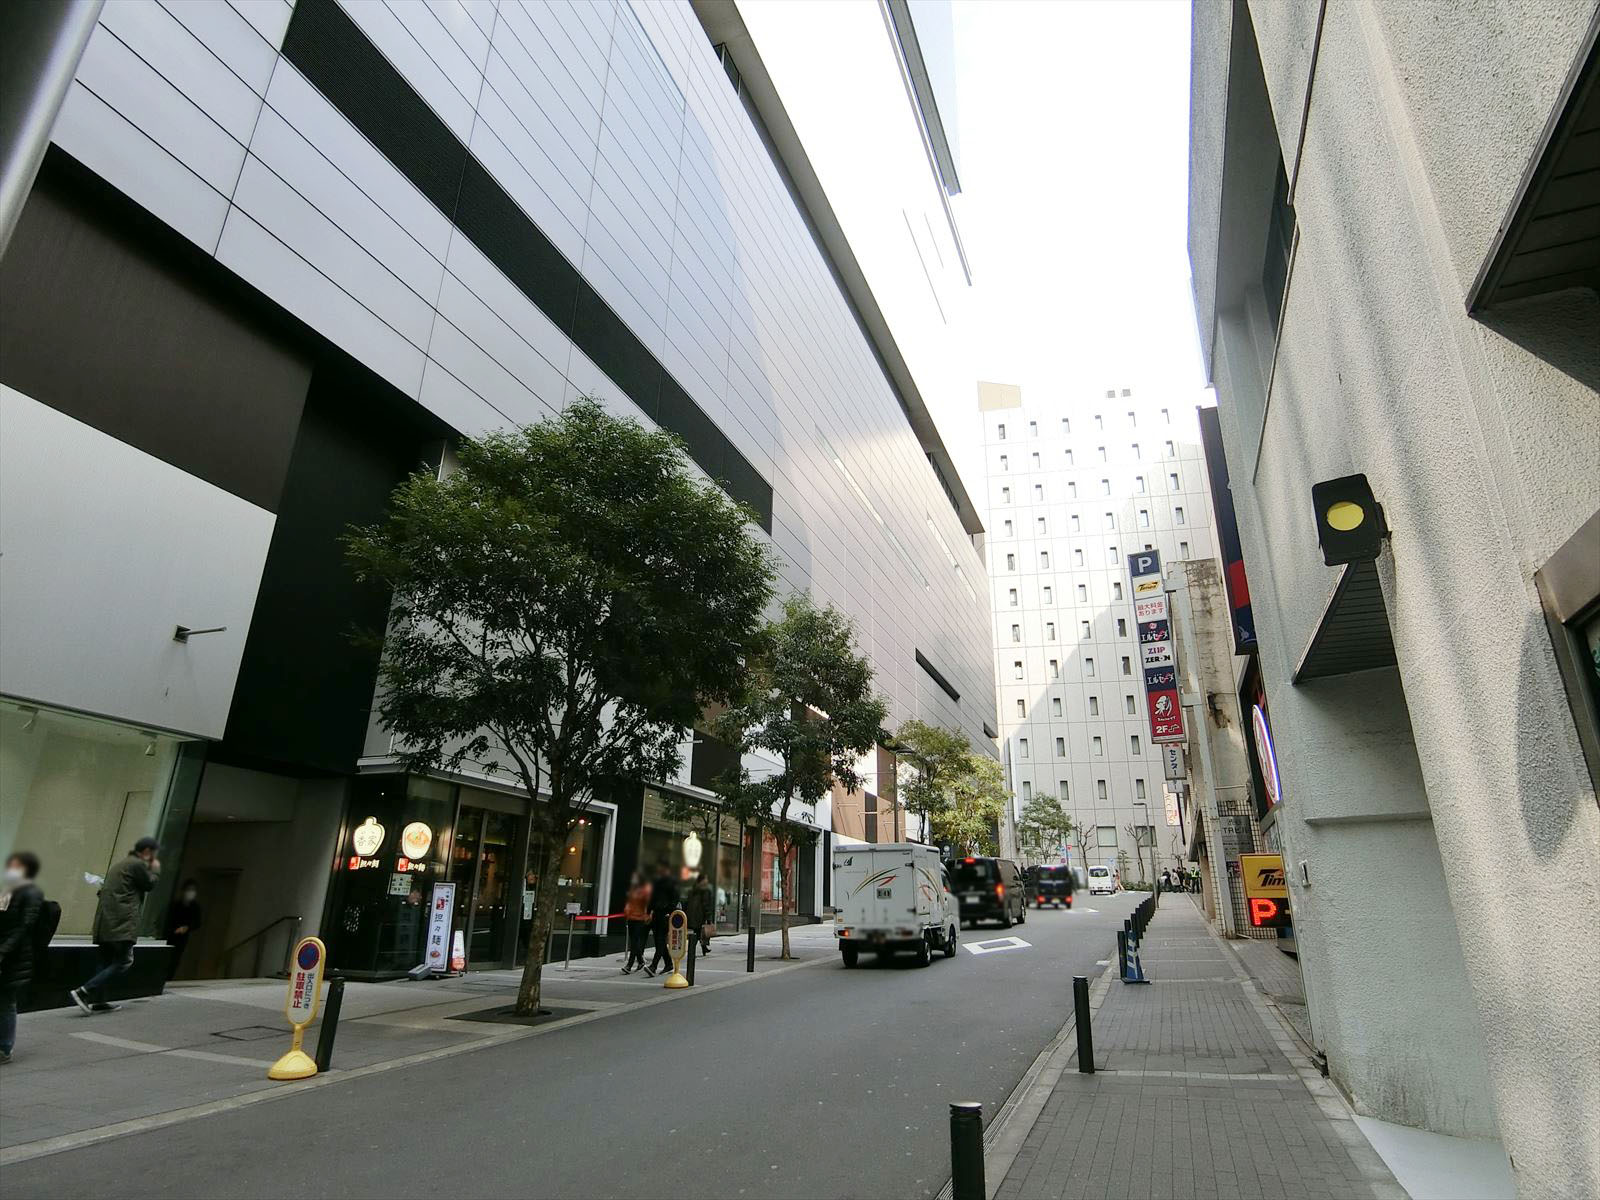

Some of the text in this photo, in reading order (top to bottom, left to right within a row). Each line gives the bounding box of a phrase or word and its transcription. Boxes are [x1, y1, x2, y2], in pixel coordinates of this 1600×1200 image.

[1138, 556, 1153, 573] P
[1138, 608, 1165, 617] あります
[1156, 724, 1168, 734] 2F
[1257, 868, 1286, 887] Tim
[1251, 898, 1277, 926] P
[431, 913, 444, 946] 担々麺
